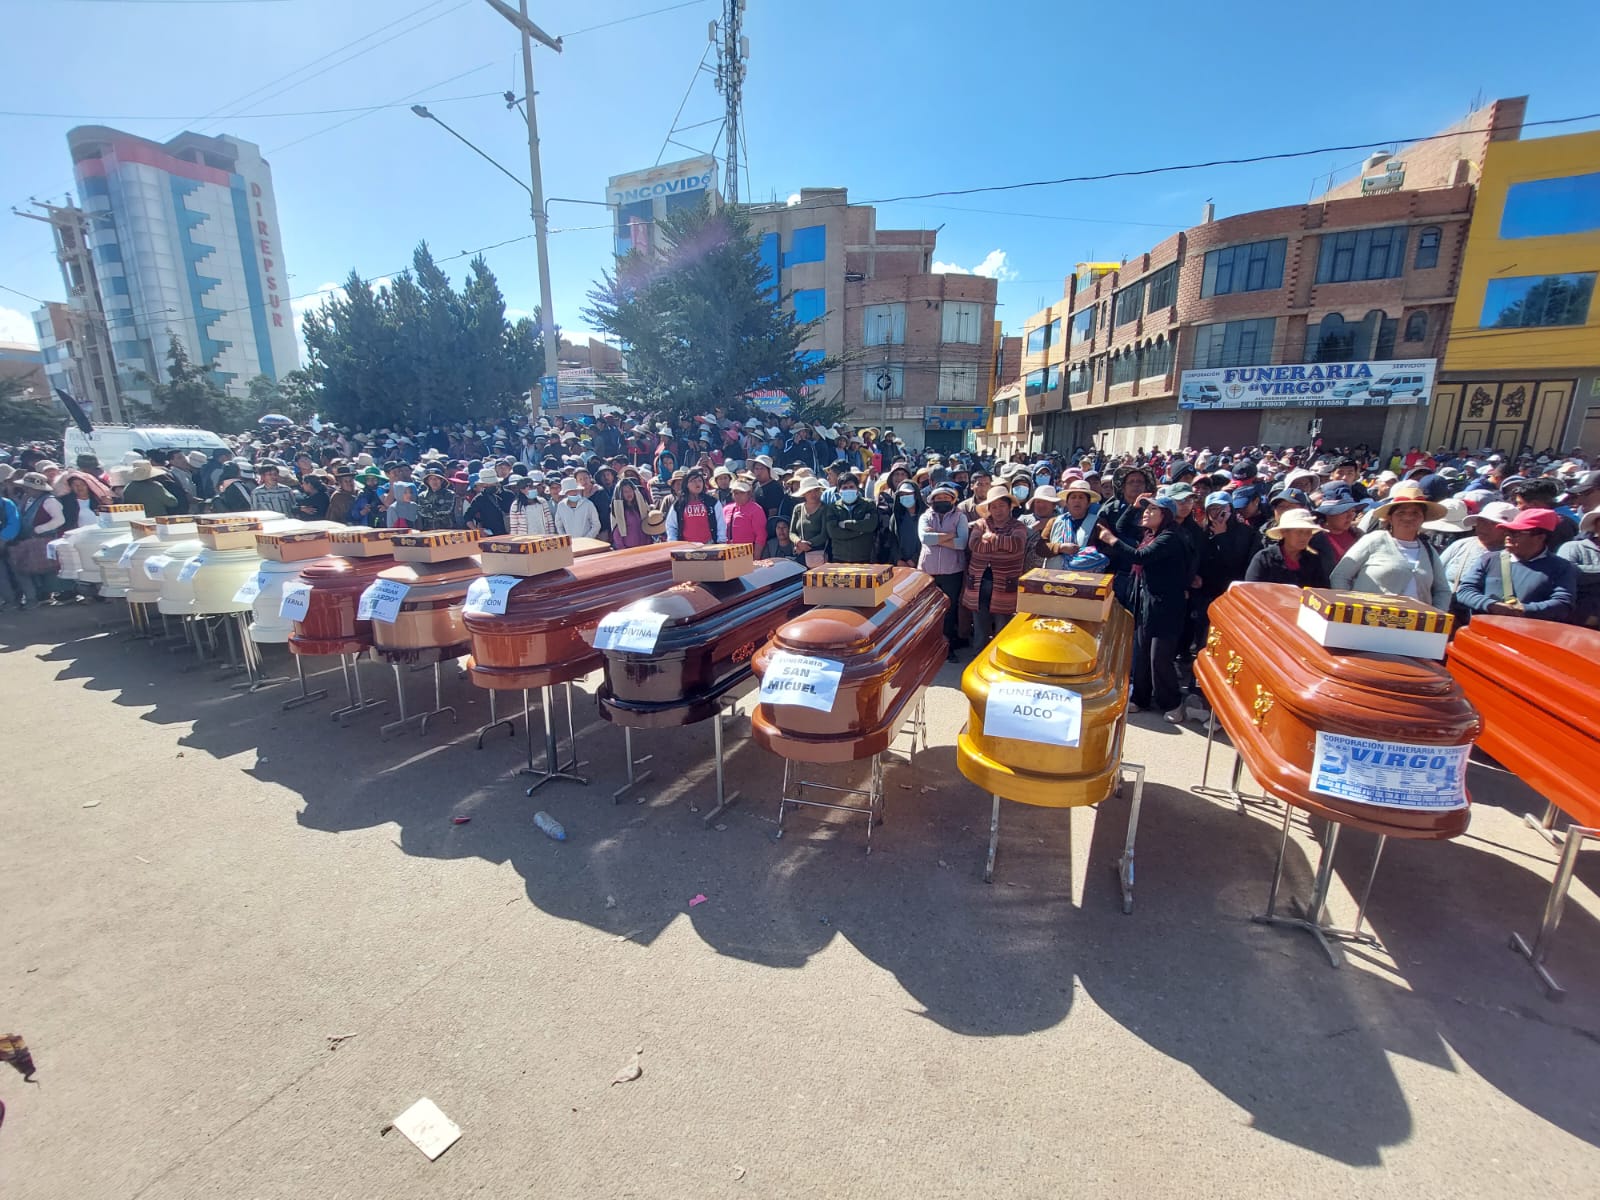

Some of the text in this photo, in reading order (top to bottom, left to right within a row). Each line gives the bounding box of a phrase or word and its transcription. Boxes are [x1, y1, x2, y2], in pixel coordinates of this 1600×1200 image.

[251, 182, 283, 328] DIREPSUR
[1223, 363, 1373, 384] FUNERARIA
[603, 625, 653, 638] LUZ DIVINA
[782, 666, 811, 678] SAN
[767, 679, 818, 695] MIGUEL
[998, 688, 1073, 703] FUNERARIA
[1012, 704, 1053, 719] ADCO
[1387, 744, 1435, 755] FUNERARIA
